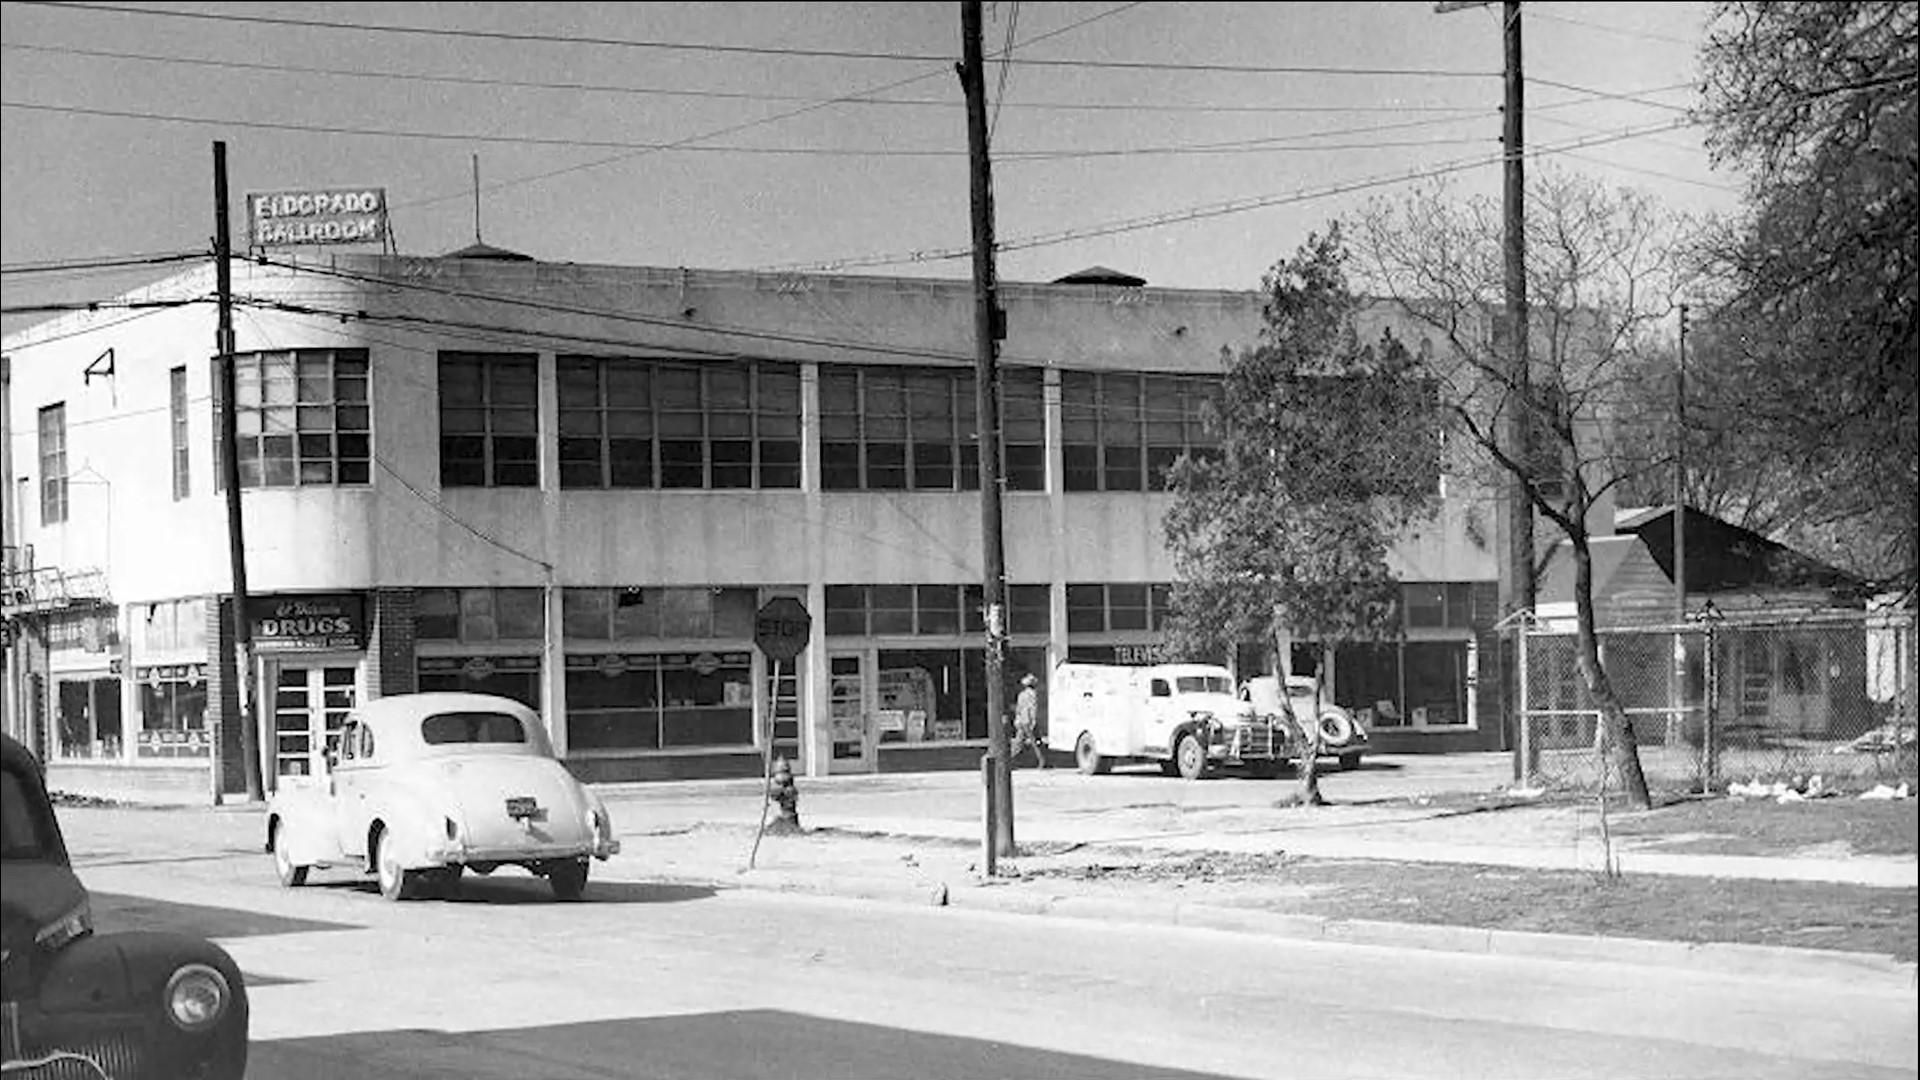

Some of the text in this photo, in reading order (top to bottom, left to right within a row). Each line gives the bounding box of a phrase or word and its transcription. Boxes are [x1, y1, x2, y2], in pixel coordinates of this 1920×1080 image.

[255, 191, 378, 217] ELDORADO
[258, 217, 377, 243] BALLROOM
[261, 616, 350, 636] DRUGS
[757, 618, 808, 637] STOP
[1114, 645, 1167, 664] TELEVIS
